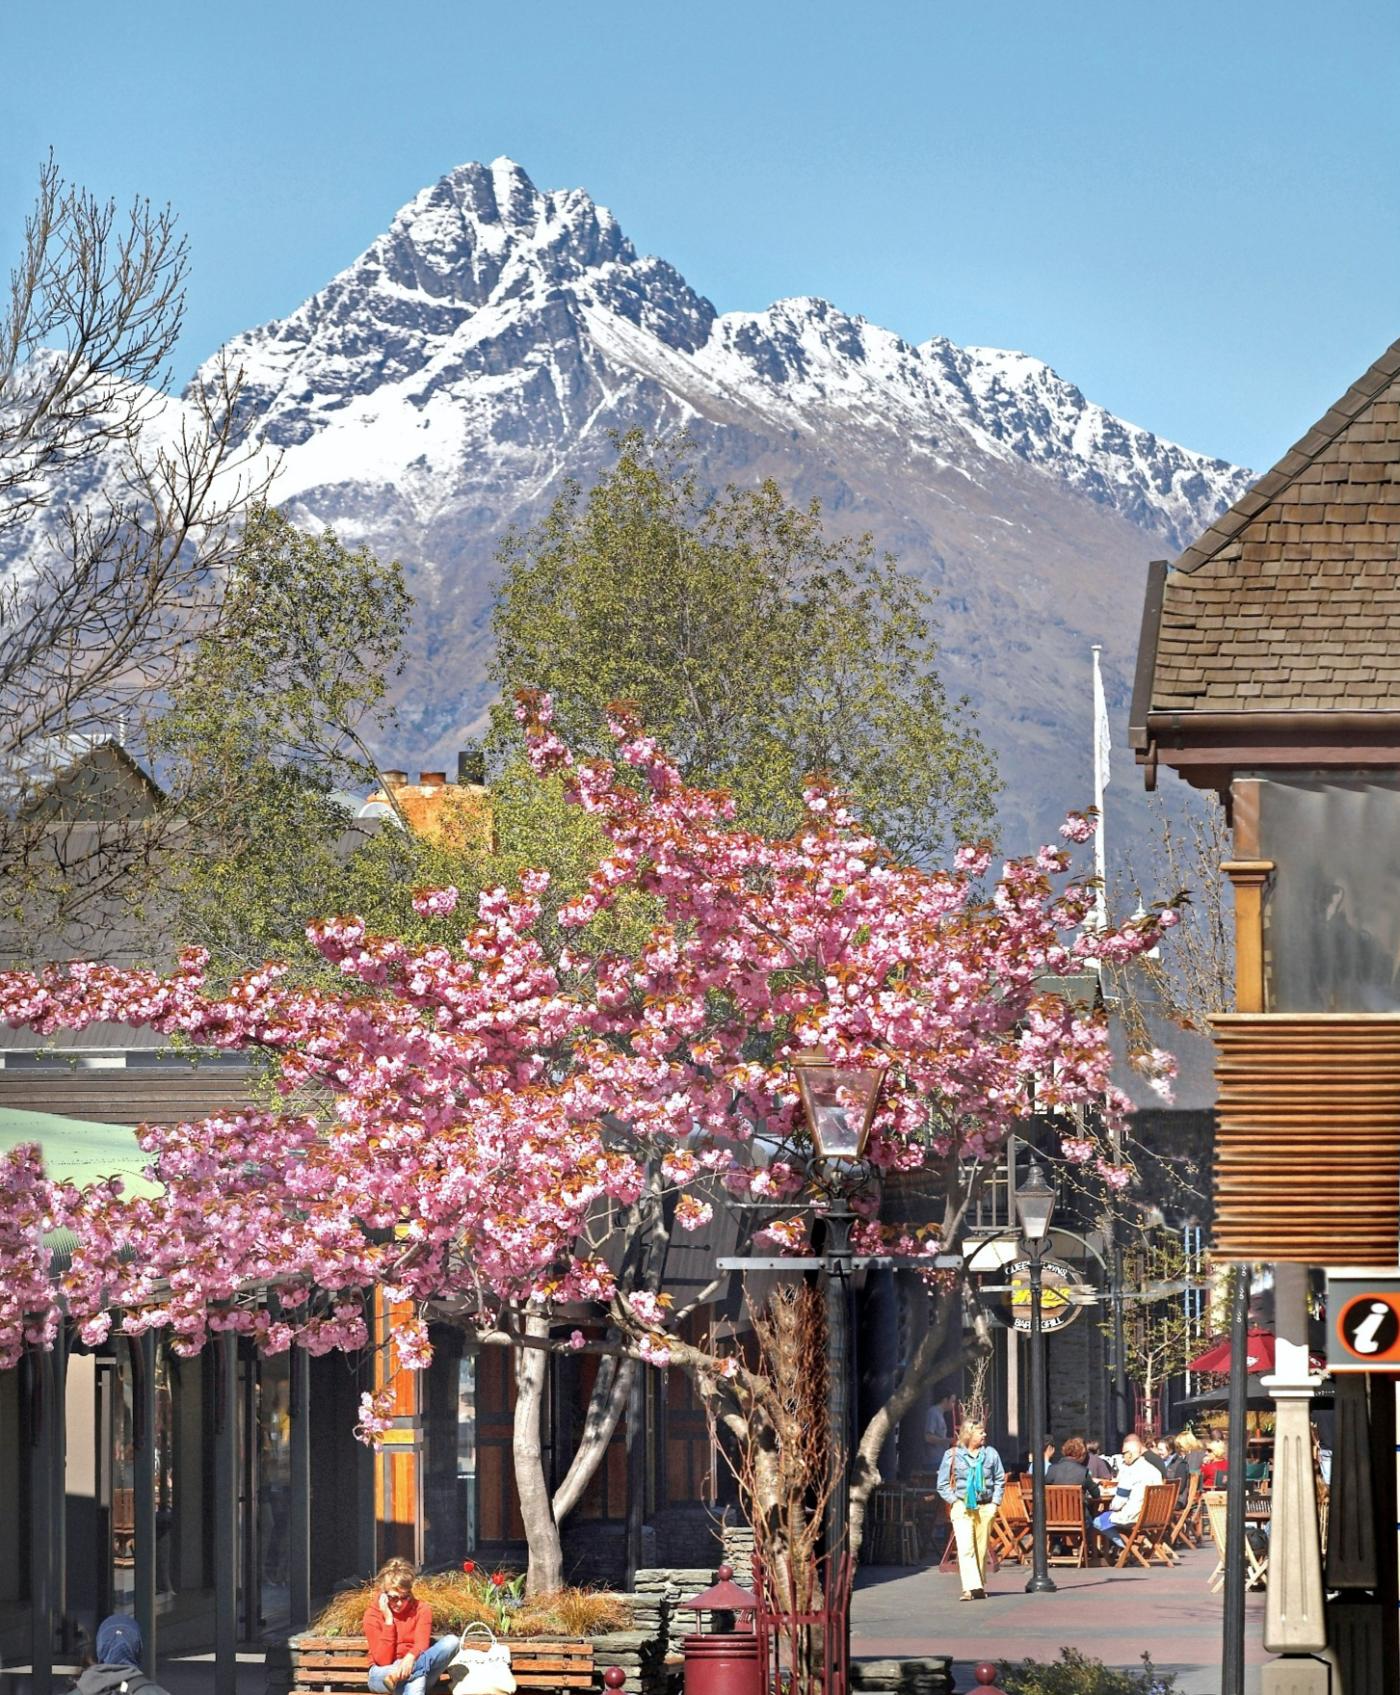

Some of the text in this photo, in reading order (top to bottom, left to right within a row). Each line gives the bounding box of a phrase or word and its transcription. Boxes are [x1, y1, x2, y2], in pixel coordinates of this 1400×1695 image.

[1005, 1260, 1068, 1277] QUEEWNS
[1014, 1316, 1064, 1329] BAR GRILL
[1352, 1302, 1389, 1354] i
